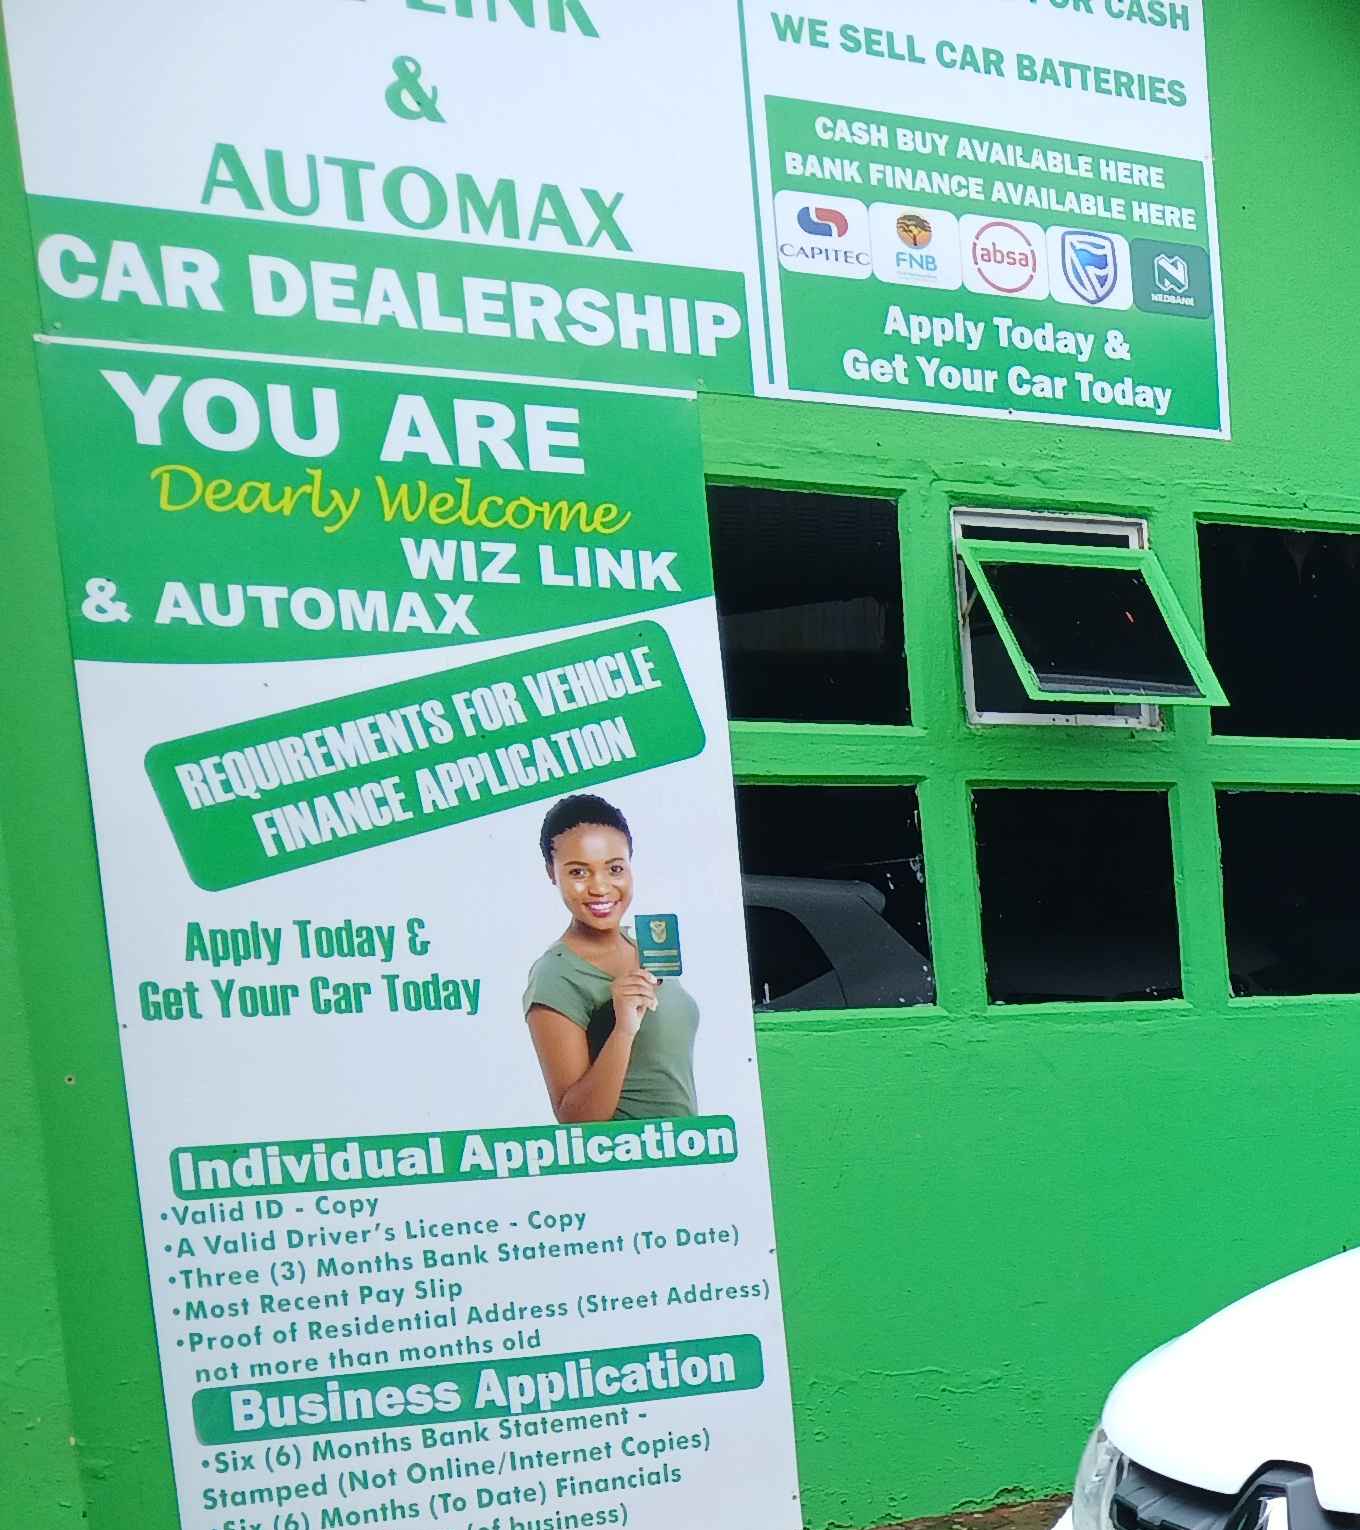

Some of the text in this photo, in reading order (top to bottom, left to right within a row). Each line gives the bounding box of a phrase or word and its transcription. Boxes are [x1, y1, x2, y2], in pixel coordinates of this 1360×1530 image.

[1104, 0, 1190, 31] CASH
[383, 54, 447, 123] &
[770, 11, 1188, 108] WE SELL CAR BATTERIES
[814, 116, 1166, 190] CASH BUY AVAILABLE HERE
[199, 142, 633, 252] AUTOMAX
[784, 152, 1198, 231] BANK FINANCE AVAILABLE HERE
[780, 242, 871, 267] CAPITEC
[896, 251, 938, 272] FNB
[980, 244, 1029, 268] absa
[37, 233, 742, 356] CAR DEALERSHIP
[884, 305, 1132, 361] Apply Today &
[842, 349, 1172, 416] Get Your Car Today
[101, 369, 585, 475] YOU ARE
[150, 464, 631, 534] Dearly Welcome
[400, 537, 682, 592] WIZ LINK
[81, 577, 480, 636] & AUTOMAX
[175, 644, 662, 811] REQUIREMENTS FOR VEHICLE
[252, 716, 637, 859] FINANCE APPLICATION
[185, 917, 430, 967] Apply Today &
[139, 971, 481, 1021] Get Your Car Today
[178, 1122, 737, 1192] Individual Application
[171, 1201, 244, 1226] Valid
[255, 1199, 283, 1220] ID
[315, 1195, 379, 1218] Copy
[177, 1238, 195, 1258] A
[204, 1230, 276, 1255] Valid
[405, 1217, 499, 1240] Licence
[528, 1210, 586, 1232] Copy
[180, 1224, 739, 1290] Three (3) Months Bank Statement (To Date)
[185, 1278, 463, 1321] Most Recent Pay Slip
[188, 1279, 770, 1352] Proof of Residential Address (Street Address)
[195, 1329, 541, 1383] not more than months old
[230, 1349, 736, 1432] Business Application
[203, 1427, 710, 1510] Stamped (Not Online/Internet Copies)
[214, 1451, 255, 1473] Six
[265, 1444, 302, 1473] (6)
[312, 1432, 412, 1462] Months
[421, 1422, 489, 1448] Bank
[499, 1408, 628, 1440] Statement
[321, 1499, 420, 1529] Months
[430, 1493, 466, 1520] (To
[476, 1481, 547, 1509] Date)
[556, 1464, 682, 1498] Financials
